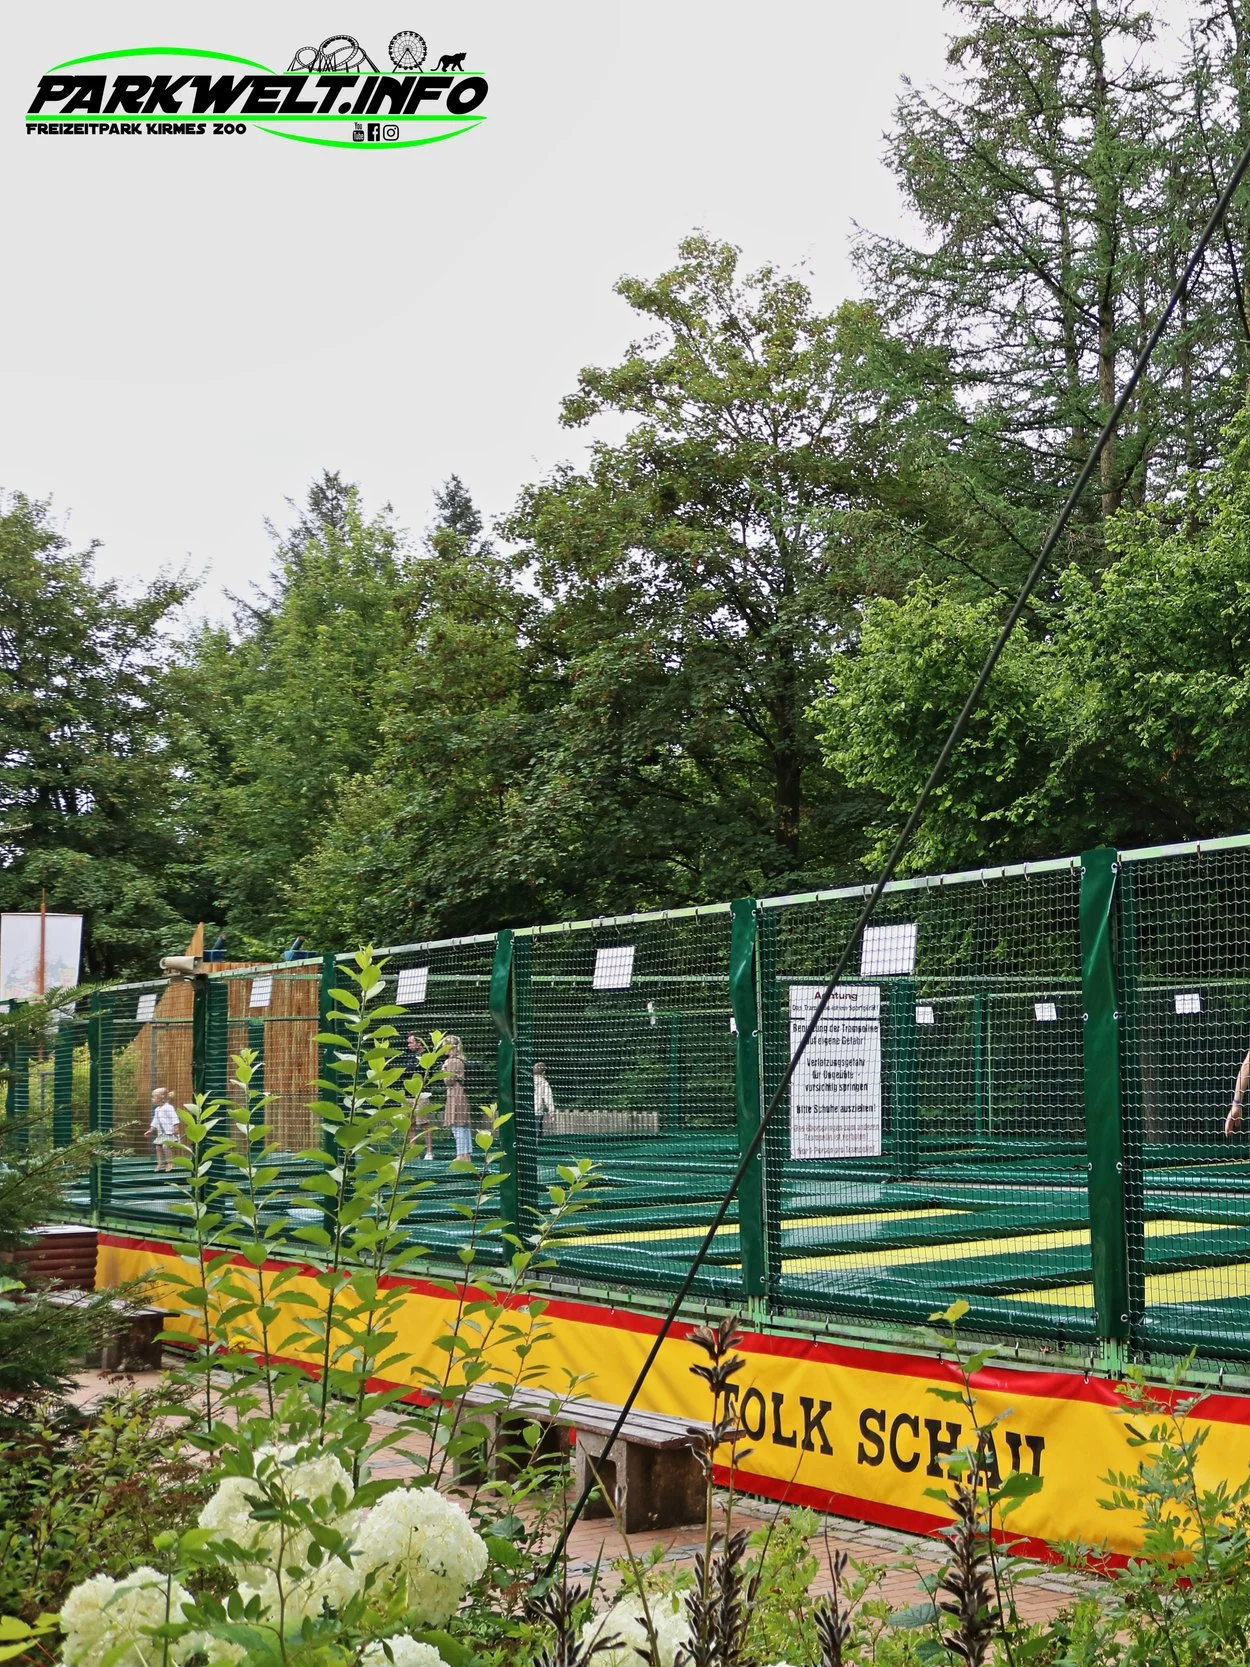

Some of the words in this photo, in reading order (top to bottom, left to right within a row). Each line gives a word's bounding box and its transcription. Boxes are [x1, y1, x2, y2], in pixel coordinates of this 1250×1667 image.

[815, 991, 858, 1001] Ahtung
[718, 1382, 833, 1456] TOLK
[857, 1408, 1045, 1490] SCHAU
